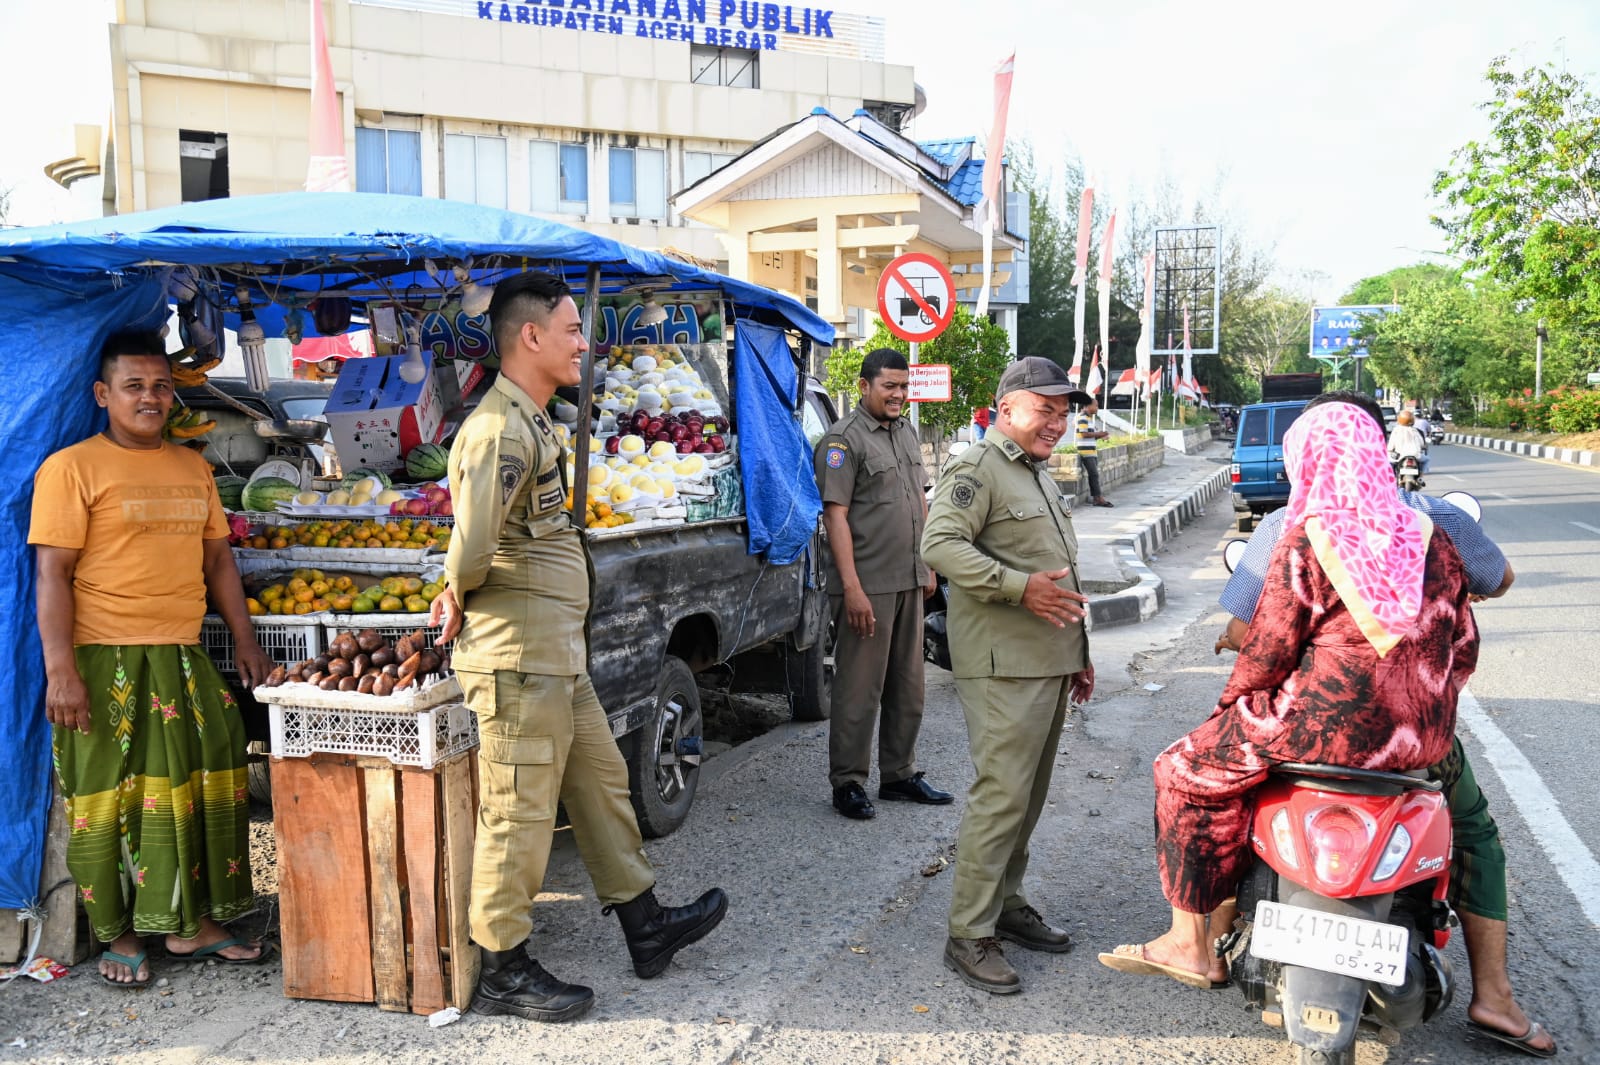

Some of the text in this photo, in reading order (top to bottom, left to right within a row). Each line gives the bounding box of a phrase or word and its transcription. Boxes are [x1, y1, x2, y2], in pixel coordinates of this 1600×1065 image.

[478, 1, 777, 51] KABUPATEN ACEH BESAR
[719, 0, 834, 38] PUBLIK
[581, 304, 700, 356] UAH
[1328, 320, 1363, 329] RAMA
[1262, 907, 1287, 931] BL
[1292, 914, 1348, 942] 4170
